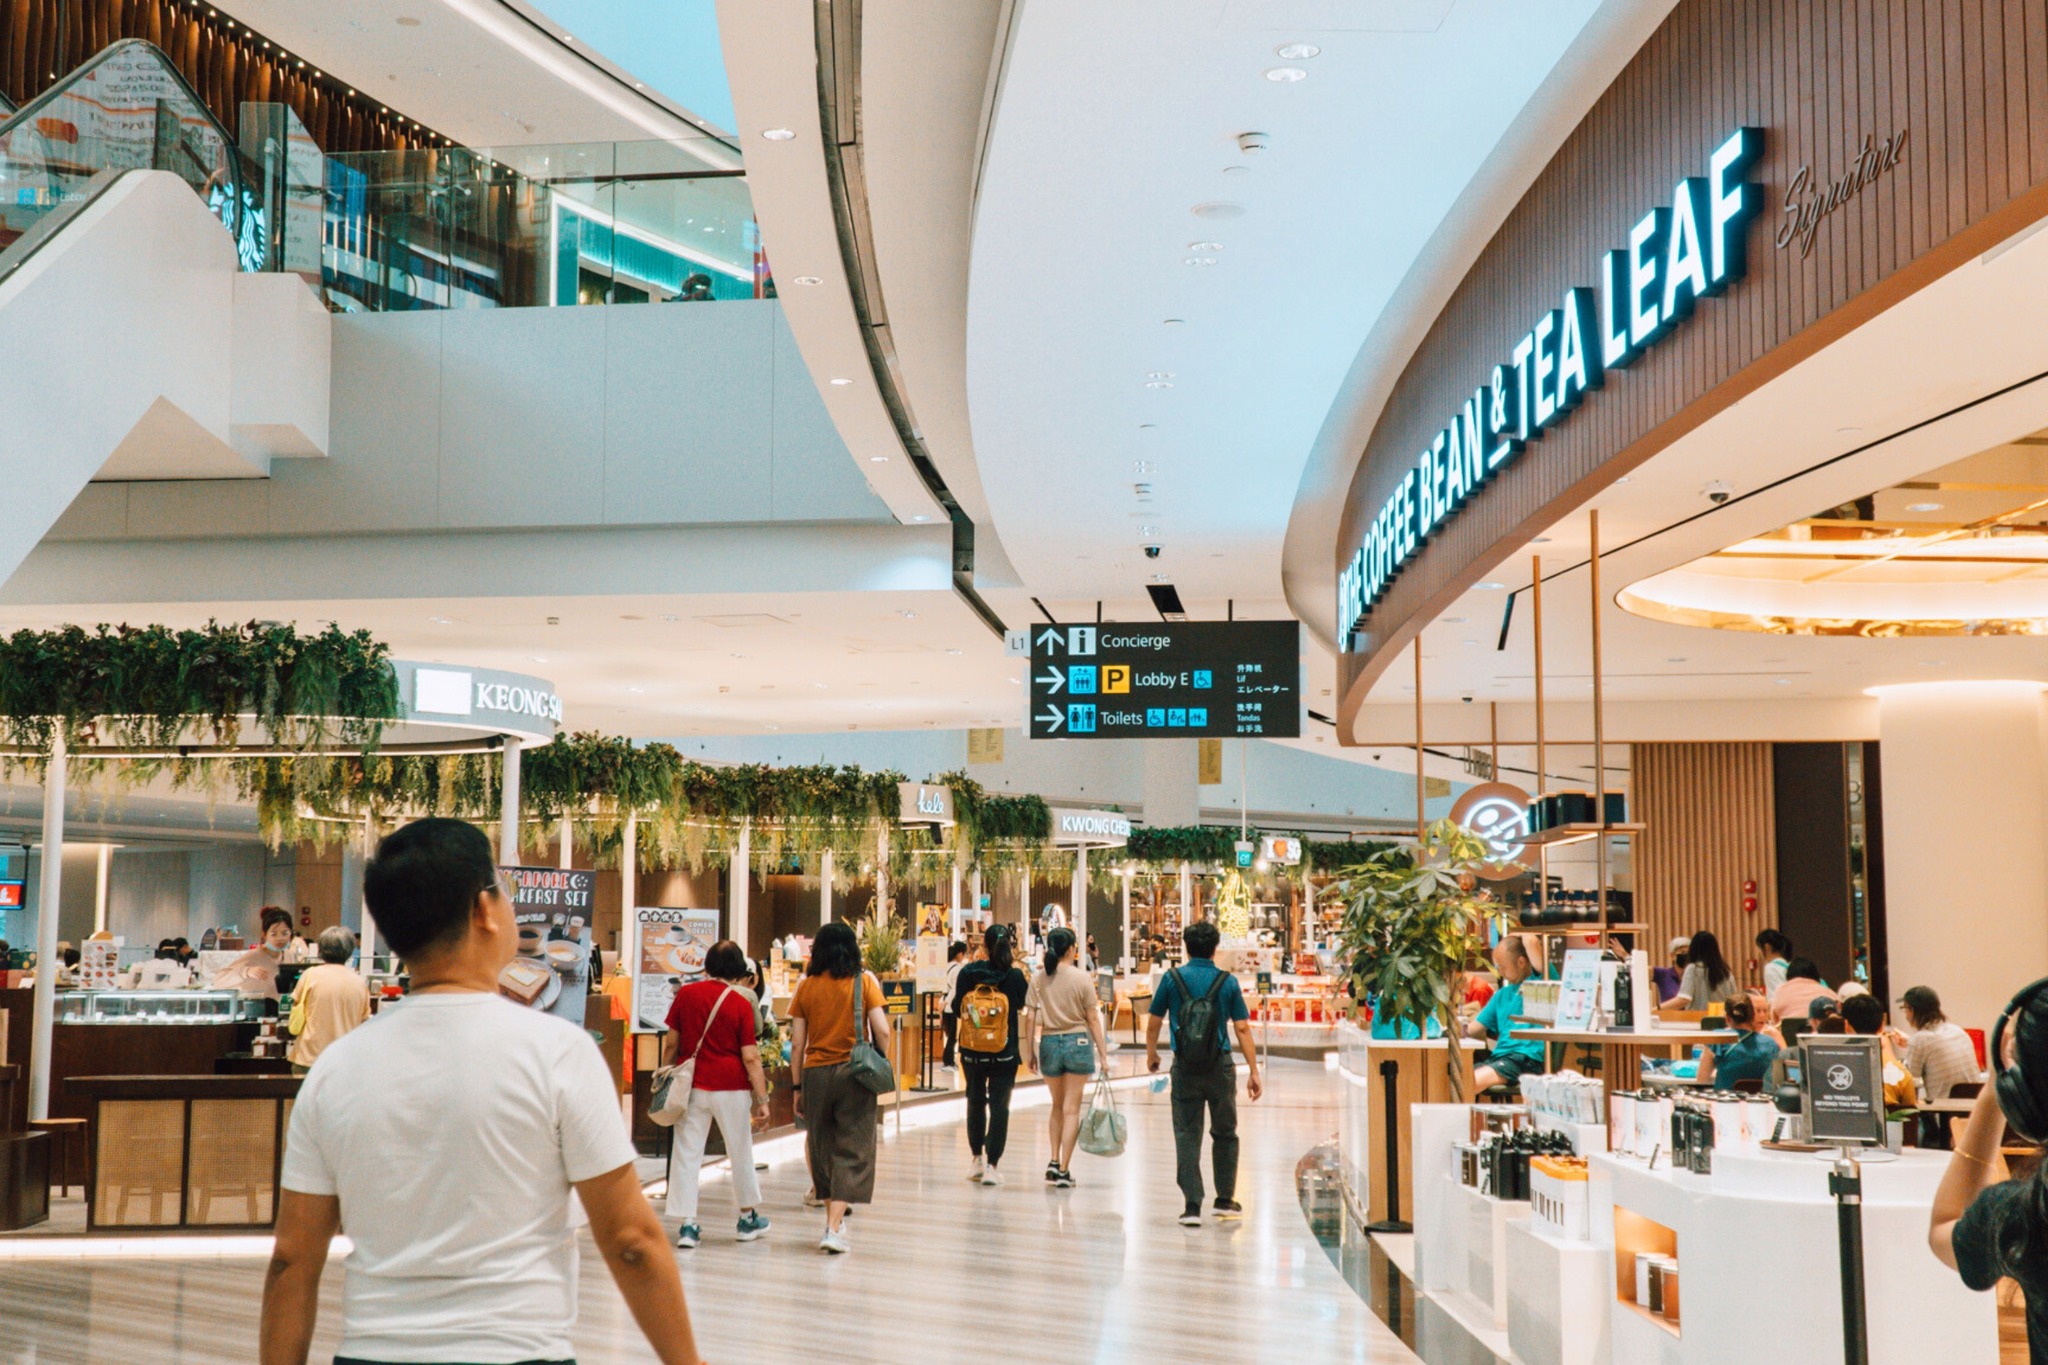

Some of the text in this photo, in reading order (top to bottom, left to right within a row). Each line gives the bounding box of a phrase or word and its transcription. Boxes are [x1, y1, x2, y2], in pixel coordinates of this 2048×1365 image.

[1776, 129, 1906, 259] Signature
[1362, 473, 1416, 605] COFFEE
[1420, 386, 1484, 538] BEAN
[1490, 365, 1508, 434] &
[1512, 288, 1588, 441] TEA
[1602, 127, 1745, 369] LEAF
[1011, 637, 1025, 650] L1
[1101, 634, 1171, 650] Concierge
[1135, 673, 1177, 689] Lobby
[1180, 673, 1189, 686] E
[1237, 685, 1289, 694] エレベーター
[475, 682, 549, 718] KEONG
[1101, 711, 1143, 725] Toilets
[1062, 815, 1109, 834] KWONG
[564, 890, 588, 907] SET
